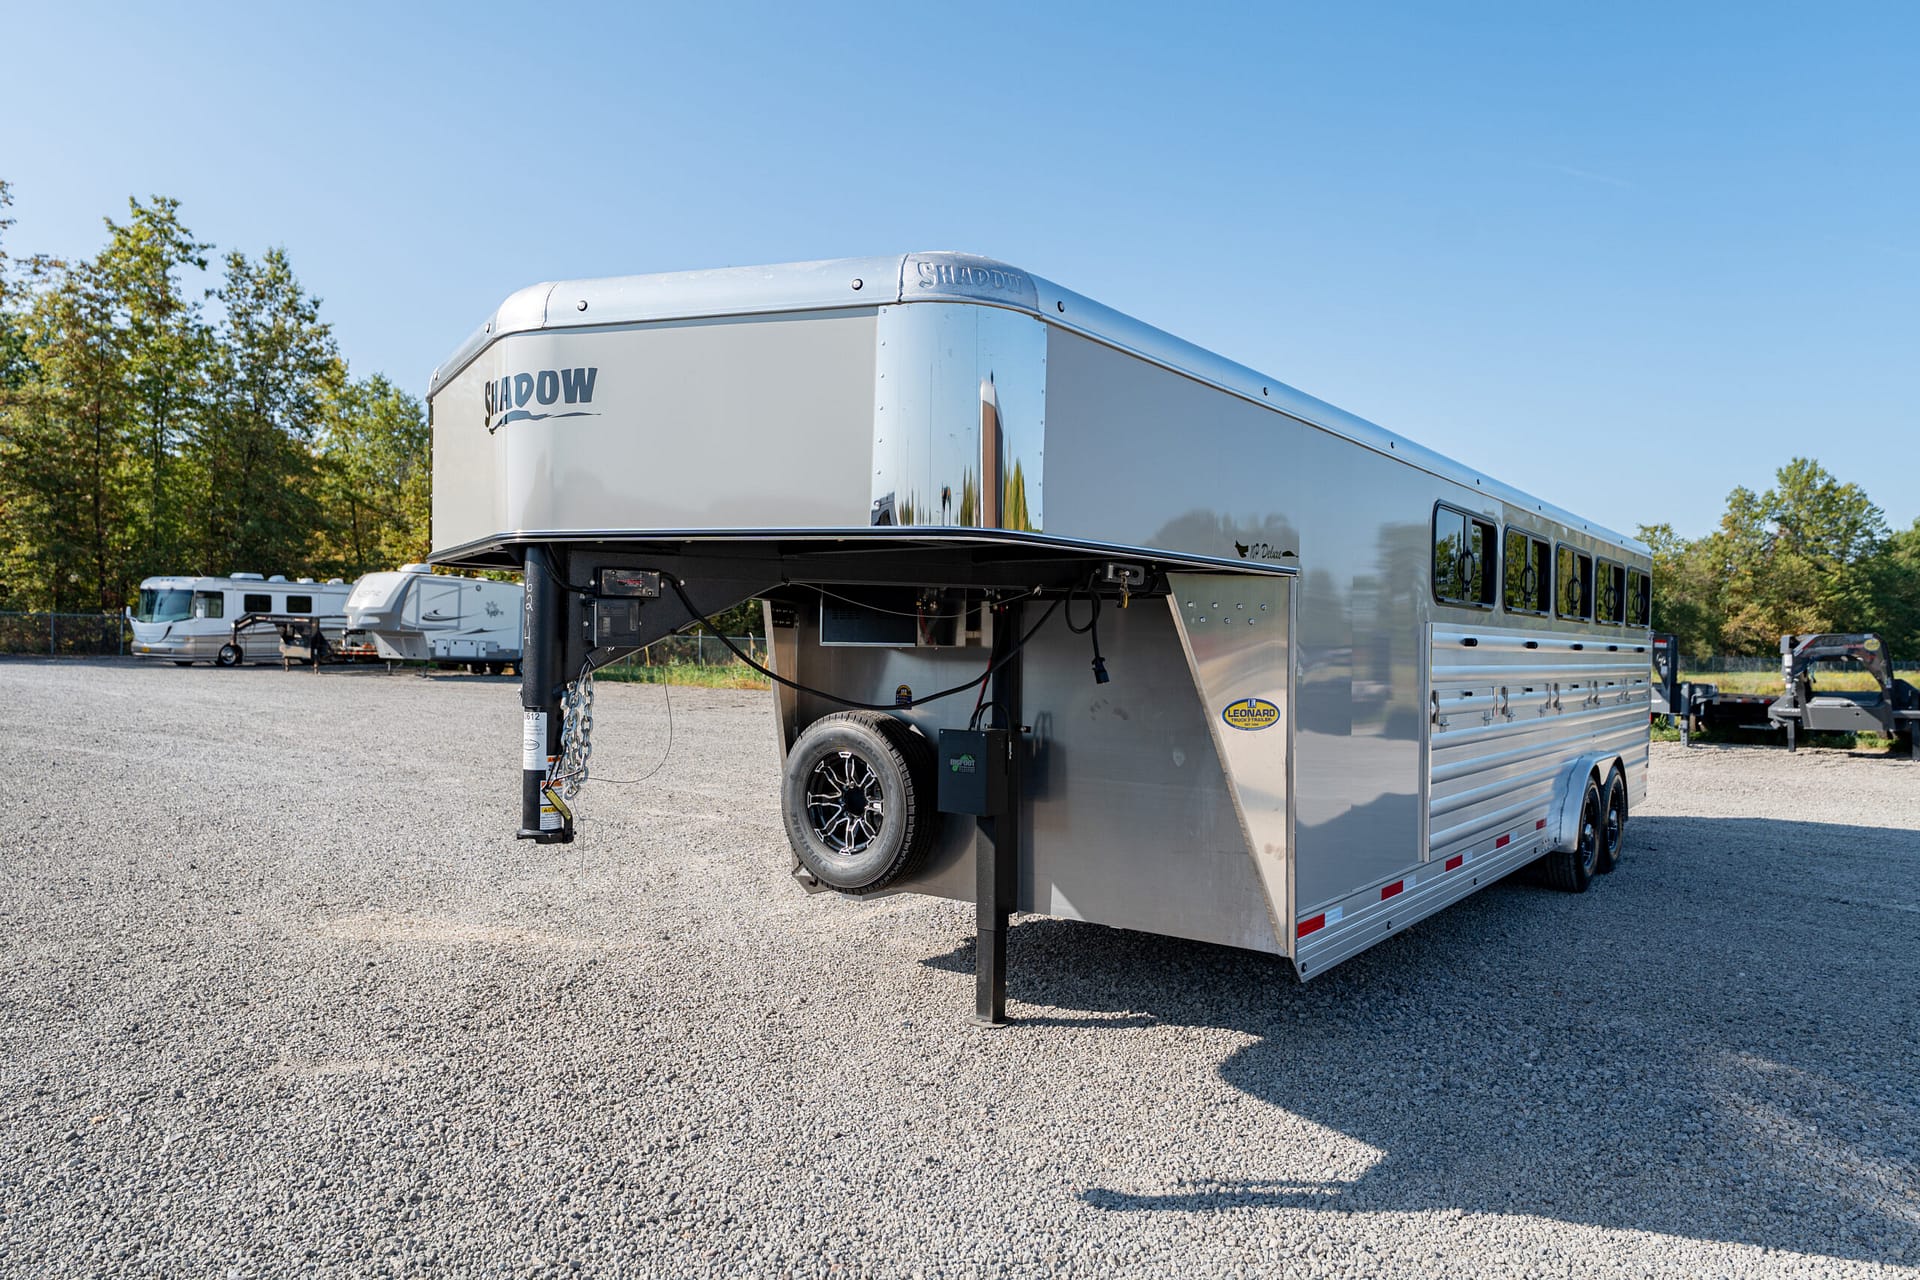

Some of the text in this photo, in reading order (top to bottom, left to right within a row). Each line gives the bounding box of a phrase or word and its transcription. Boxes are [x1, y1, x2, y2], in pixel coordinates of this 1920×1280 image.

[917, 261, 1022, 294] SHADOW
[484, 368, 598, 428] SHADOW
[1228, 709, 1275, 717] LEONARD
